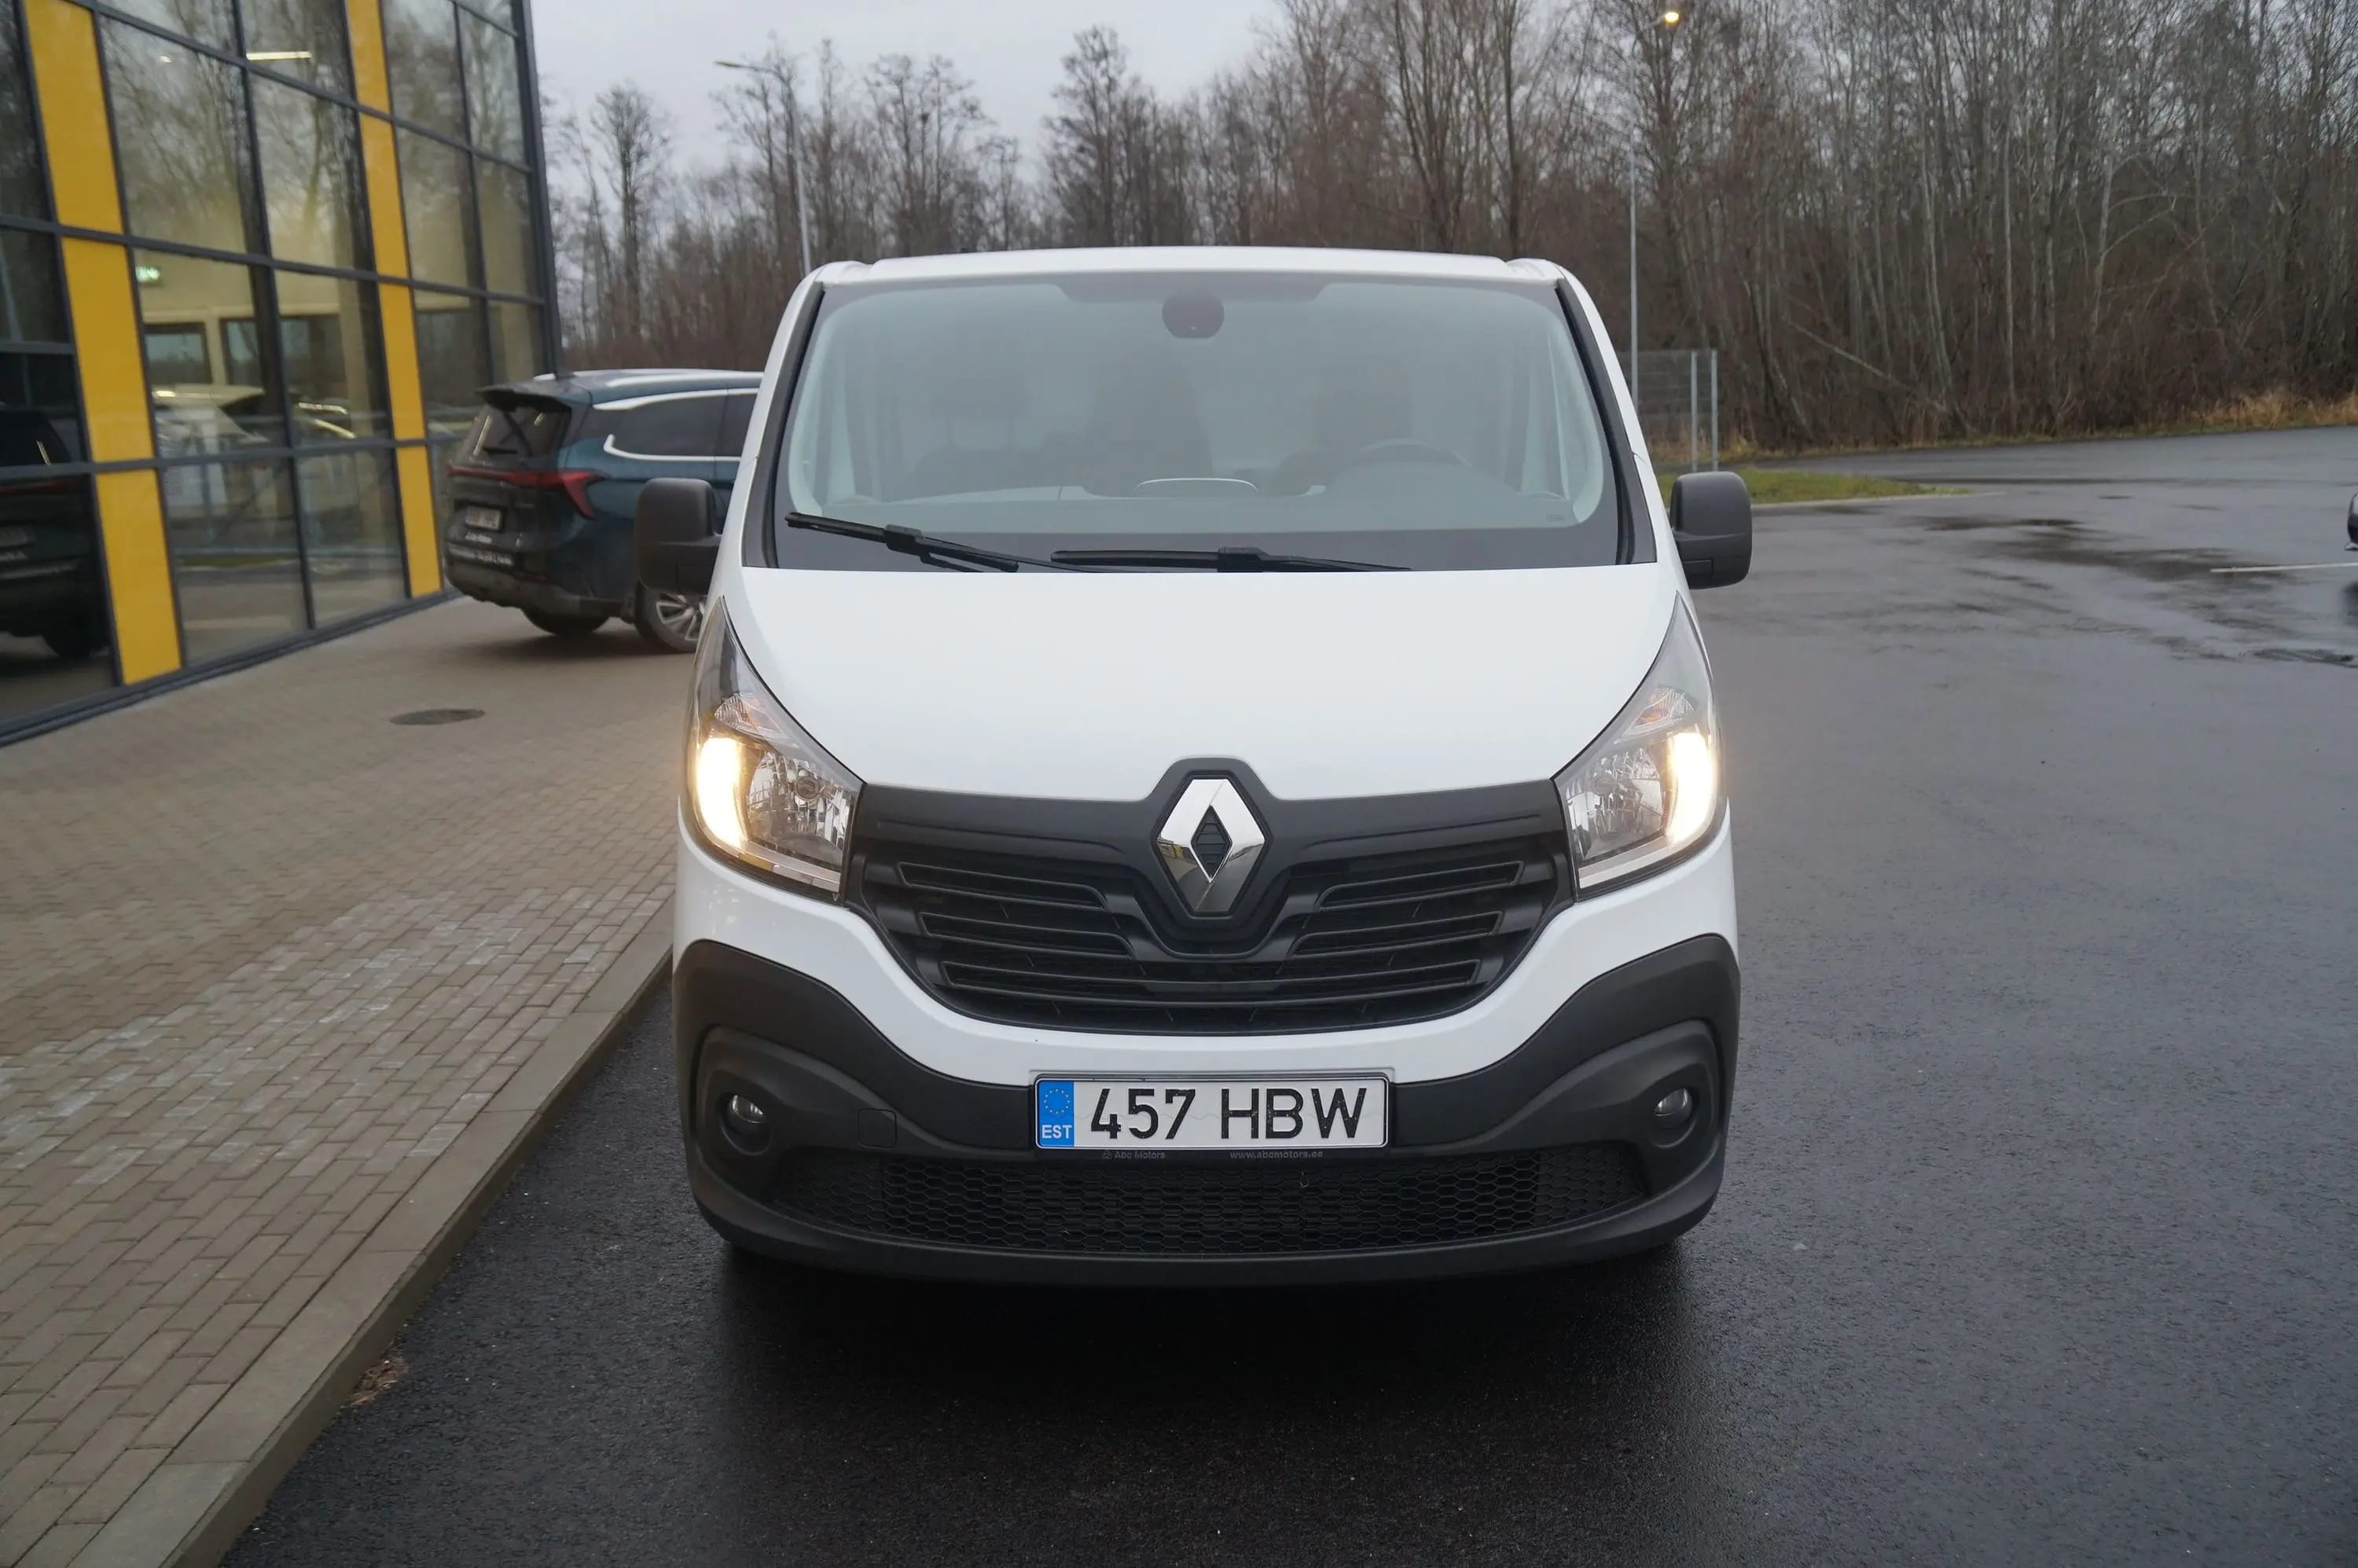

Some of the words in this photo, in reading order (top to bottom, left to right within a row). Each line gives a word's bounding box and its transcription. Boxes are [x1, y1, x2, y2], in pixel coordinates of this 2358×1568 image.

[1091, 1088, 1196, 1139] 457
[1221, 1088, 1367, 1139] HBW
[1041, 1125, 1072, 1139] EST
[1115, 1151, 1132, 1159] Abc
[1136, 1151, 1166, 1159] Motors
[1230, 1150, 1324, 1159] www.abcmotors.ee
